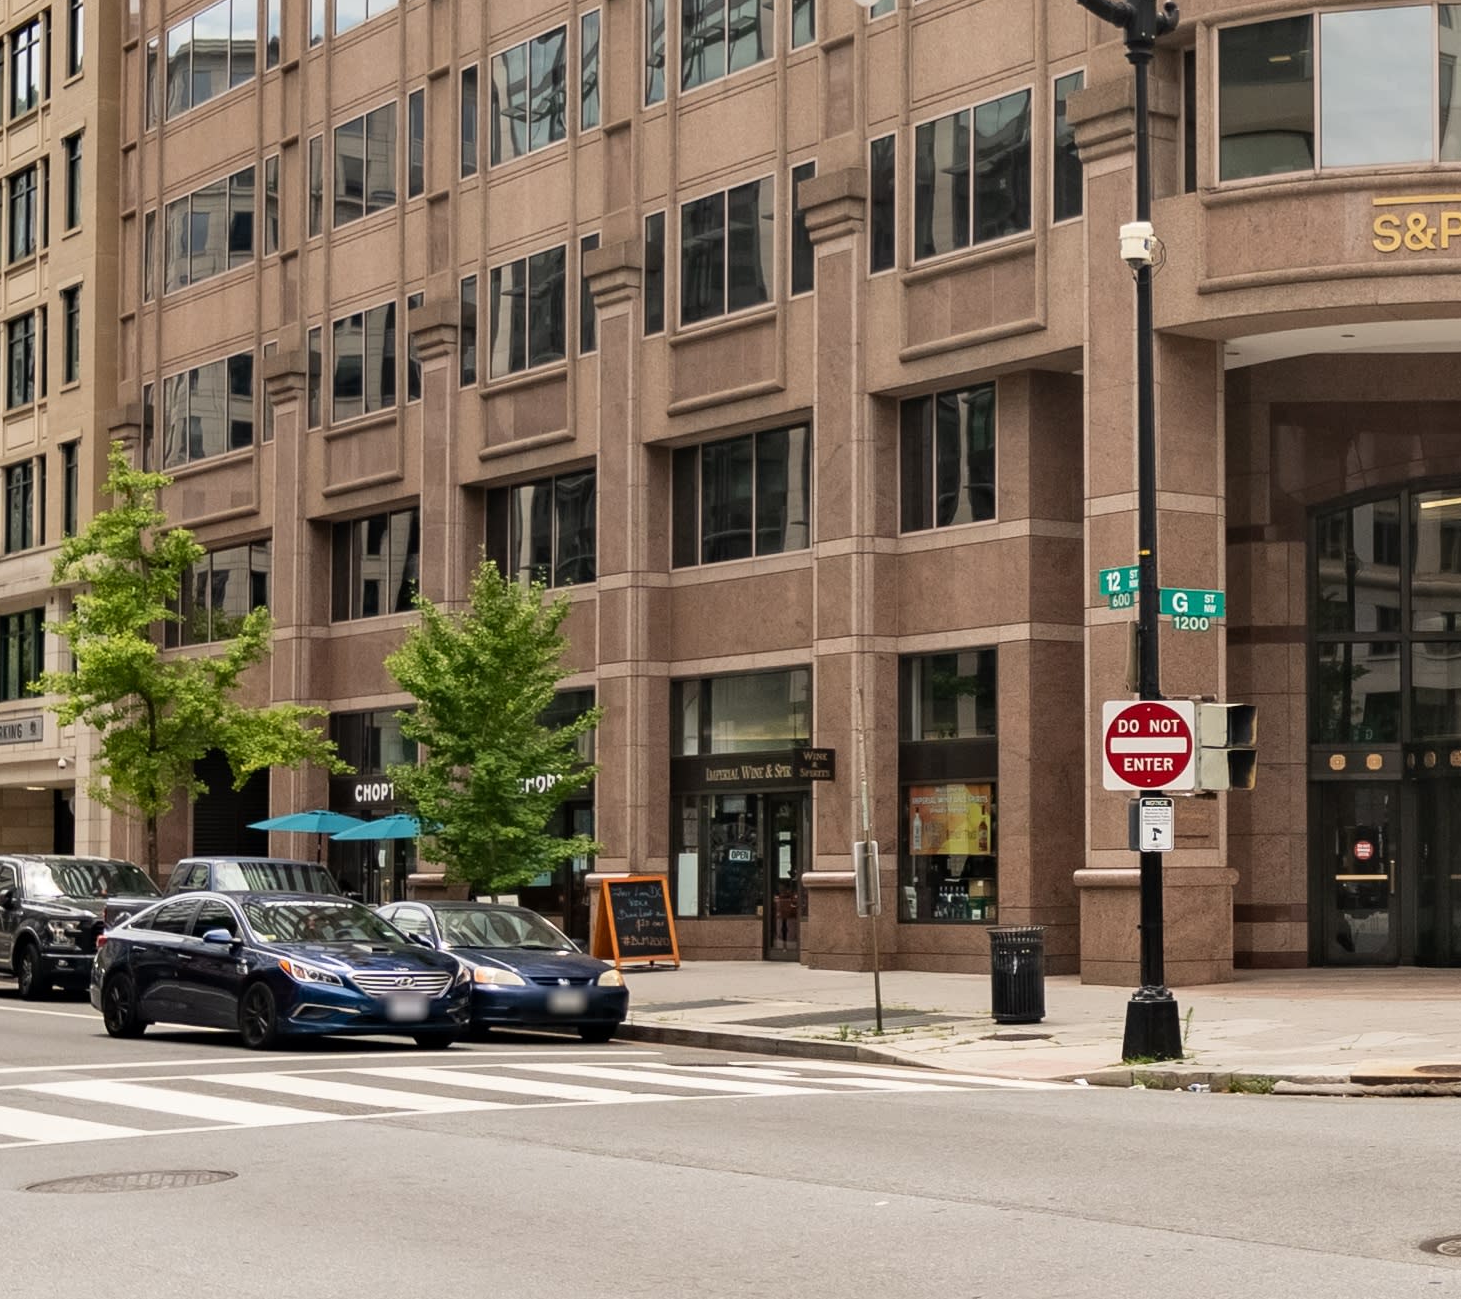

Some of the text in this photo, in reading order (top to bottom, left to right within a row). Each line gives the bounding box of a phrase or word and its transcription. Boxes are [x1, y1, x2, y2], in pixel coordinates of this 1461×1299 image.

[1106, 569, 1139, 592] 12 ST
[1112, 593, 1131, 607] 600
[1172, 592, 1216, 613] G ST
[1203, 604, 1217, 613] NW
[1173, 616, 1210, 631] 1200
[1118, 719, 1180, 733] DO NOT
[803, 751, 828, 761] WINE
[1123, 757, 1174, 771] ENTER
[706, 767, 739, 781] IMPERIAL
[740, 764, 764, 779] WINE
[765, 763, 773, 779] &
[731, 851, 749, 861] OPEN
